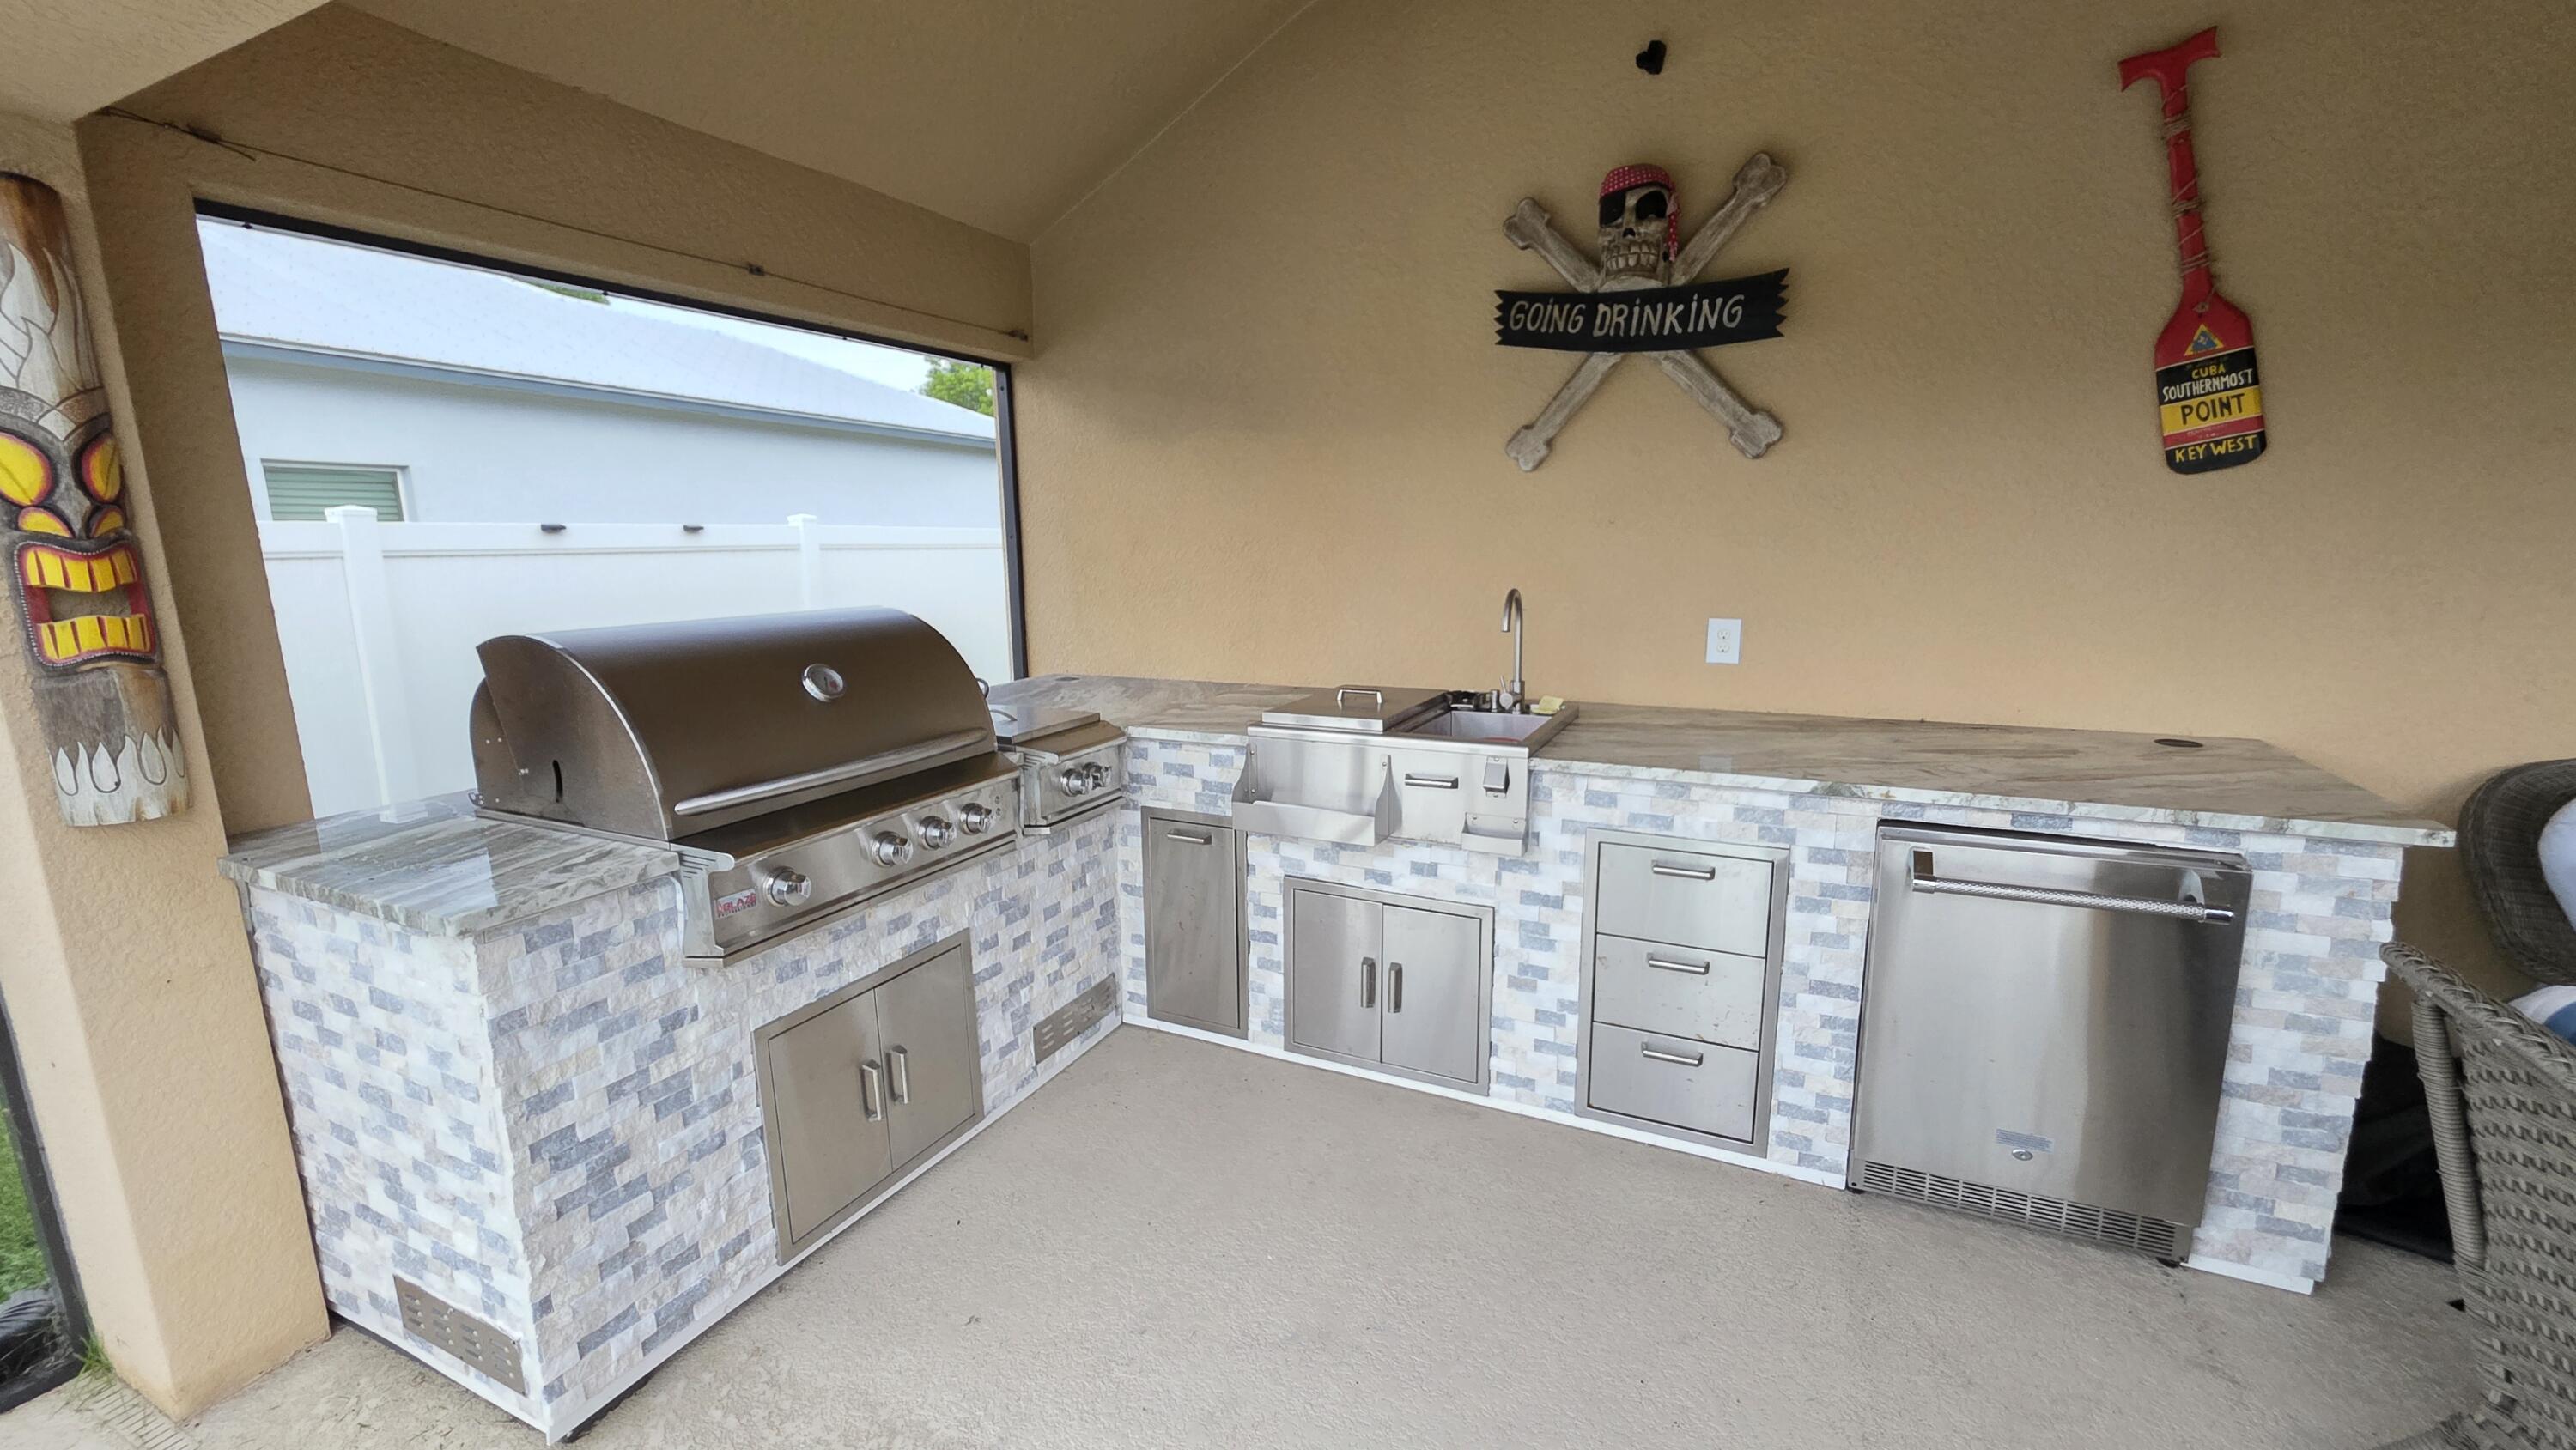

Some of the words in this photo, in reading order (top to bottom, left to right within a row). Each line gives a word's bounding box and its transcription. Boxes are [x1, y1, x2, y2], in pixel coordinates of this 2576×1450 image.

[2162, 368, 2253, 403] SOUTHERNMOST
[2191, 364, 2227, 379] CUBA
[2180, 393, 2245, 426] POINT
[2175, 443, 2208, 463] KEY
[2210, 434, 2257, 455] WEST
